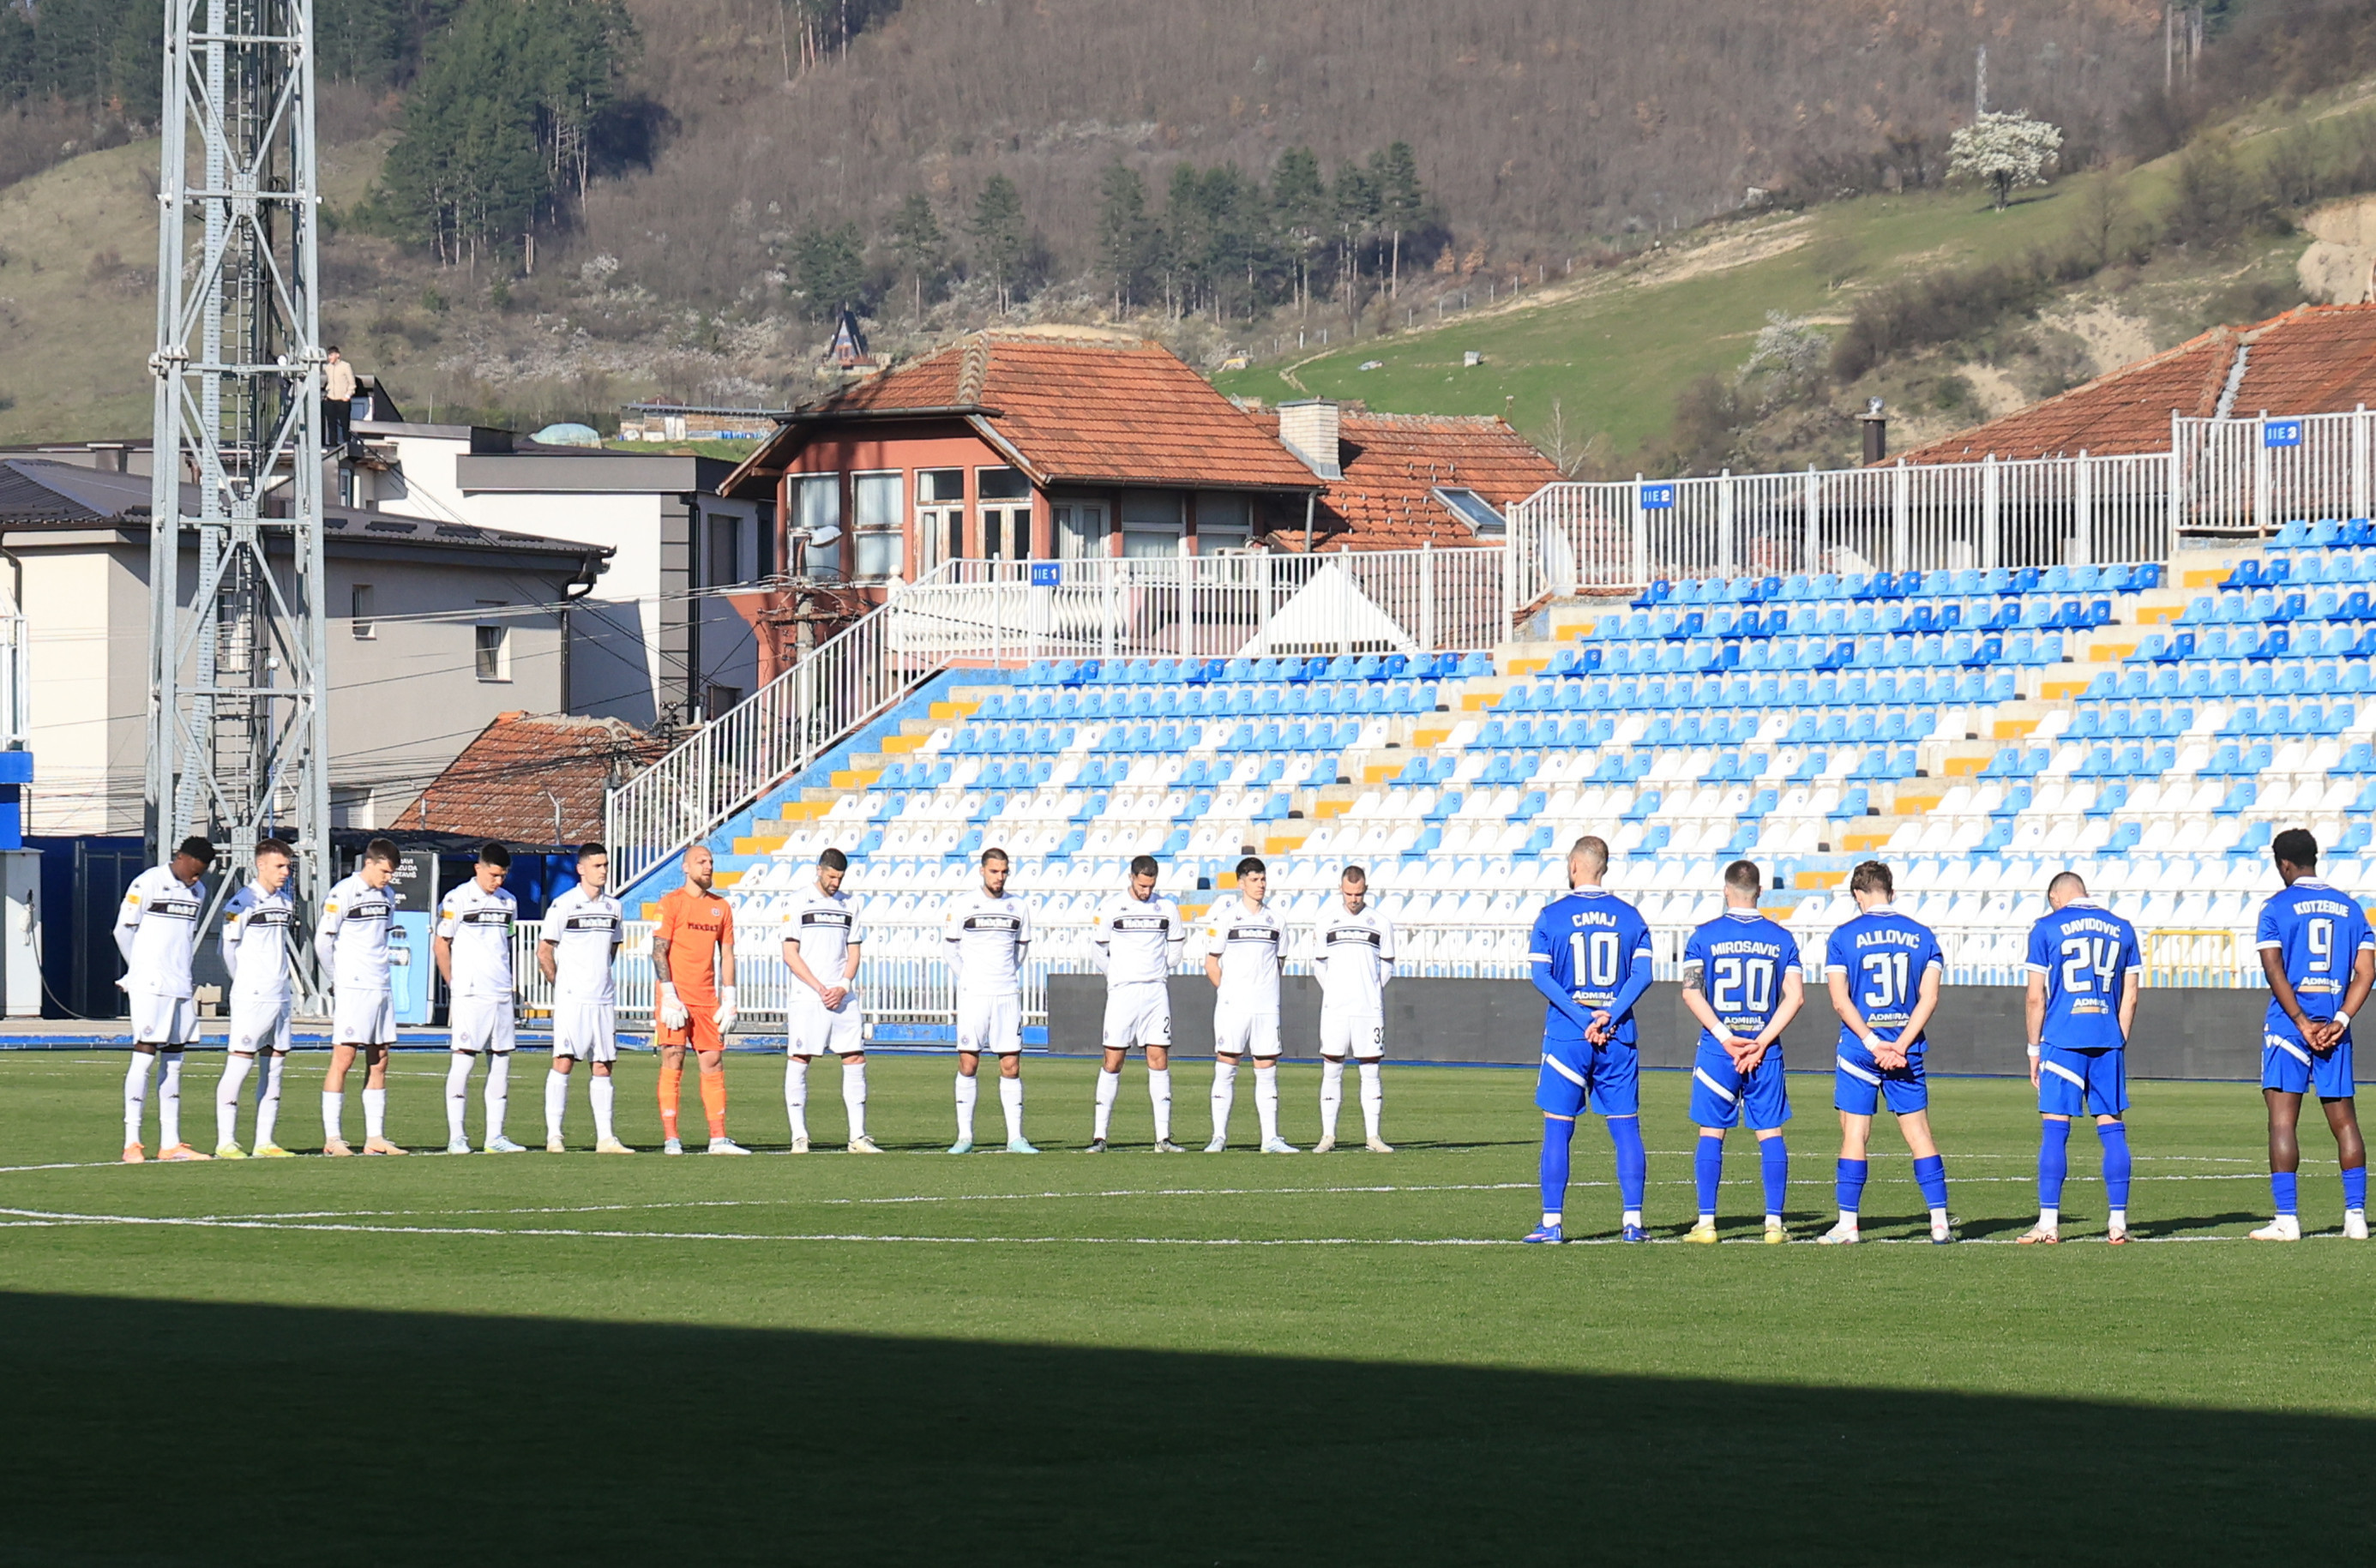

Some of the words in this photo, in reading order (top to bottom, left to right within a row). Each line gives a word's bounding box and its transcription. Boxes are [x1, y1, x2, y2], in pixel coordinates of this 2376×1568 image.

[1661, 490, 1670, 502] 2
[1033, 568, 1049, 580] IIE
[1050, 568, 1056, 580] 1
[2293, 899, 2349, 917] KOTZEBUE
[1572, 911, 1616, 927] CAMAJ
[2060, 917, 2120, 938] DAVIDOVIĆ
[1711, 940, 1780, 958] MIROSAVIĆ
[1856, 929, 1920, 949] ALILOVIĆ
[2308, 918, 2333, 971] 9
[1569, 932, 1619, 987] 10
[2061, 937, 2120, 993] 24
[1714, 958, 1775, 1012] 20
[1862, 952, 1909, 1007] 31
[1868, 1012, 1910, 1021] ADMIRA
